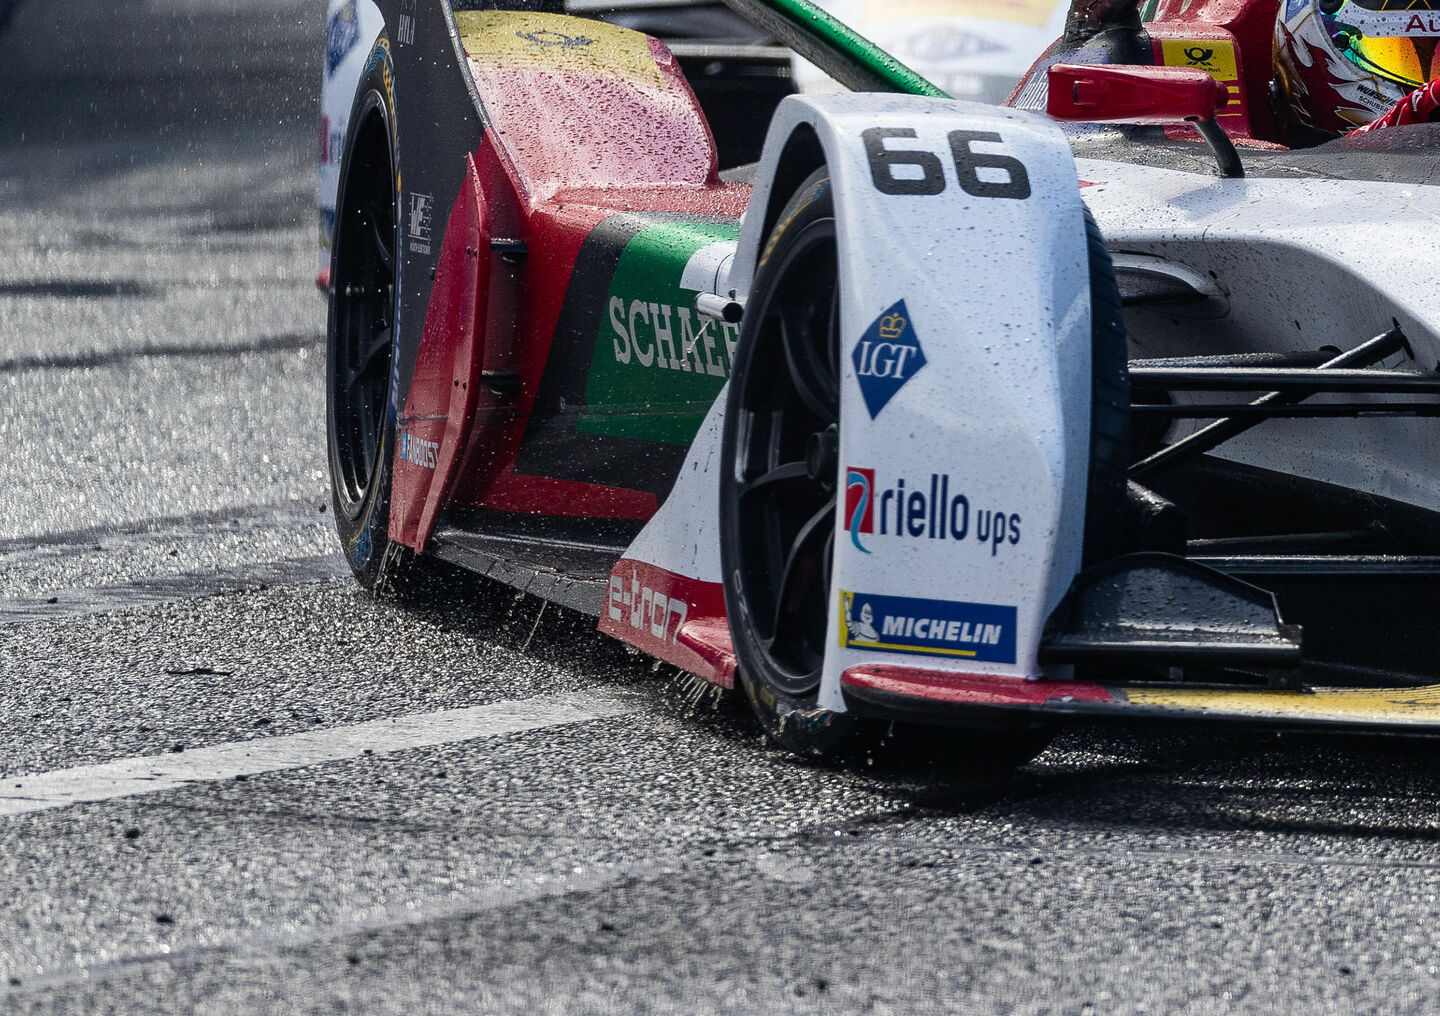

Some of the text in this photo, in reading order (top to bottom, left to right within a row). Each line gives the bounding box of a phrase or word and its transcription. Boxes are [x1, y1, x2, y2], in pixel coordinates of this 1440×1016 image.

[1359, 95, 1391, 114] SCHUBER
[861, 127, 1032, 200] 66
[609, 295, 740, 378] SCHAEF
[857, 341, 917, 379] LGT
[879, 474, 1022, 557] riello ups
[608, 569, 689, 646] e-tron
[882, 615, 1002, 645] MICHELIN
